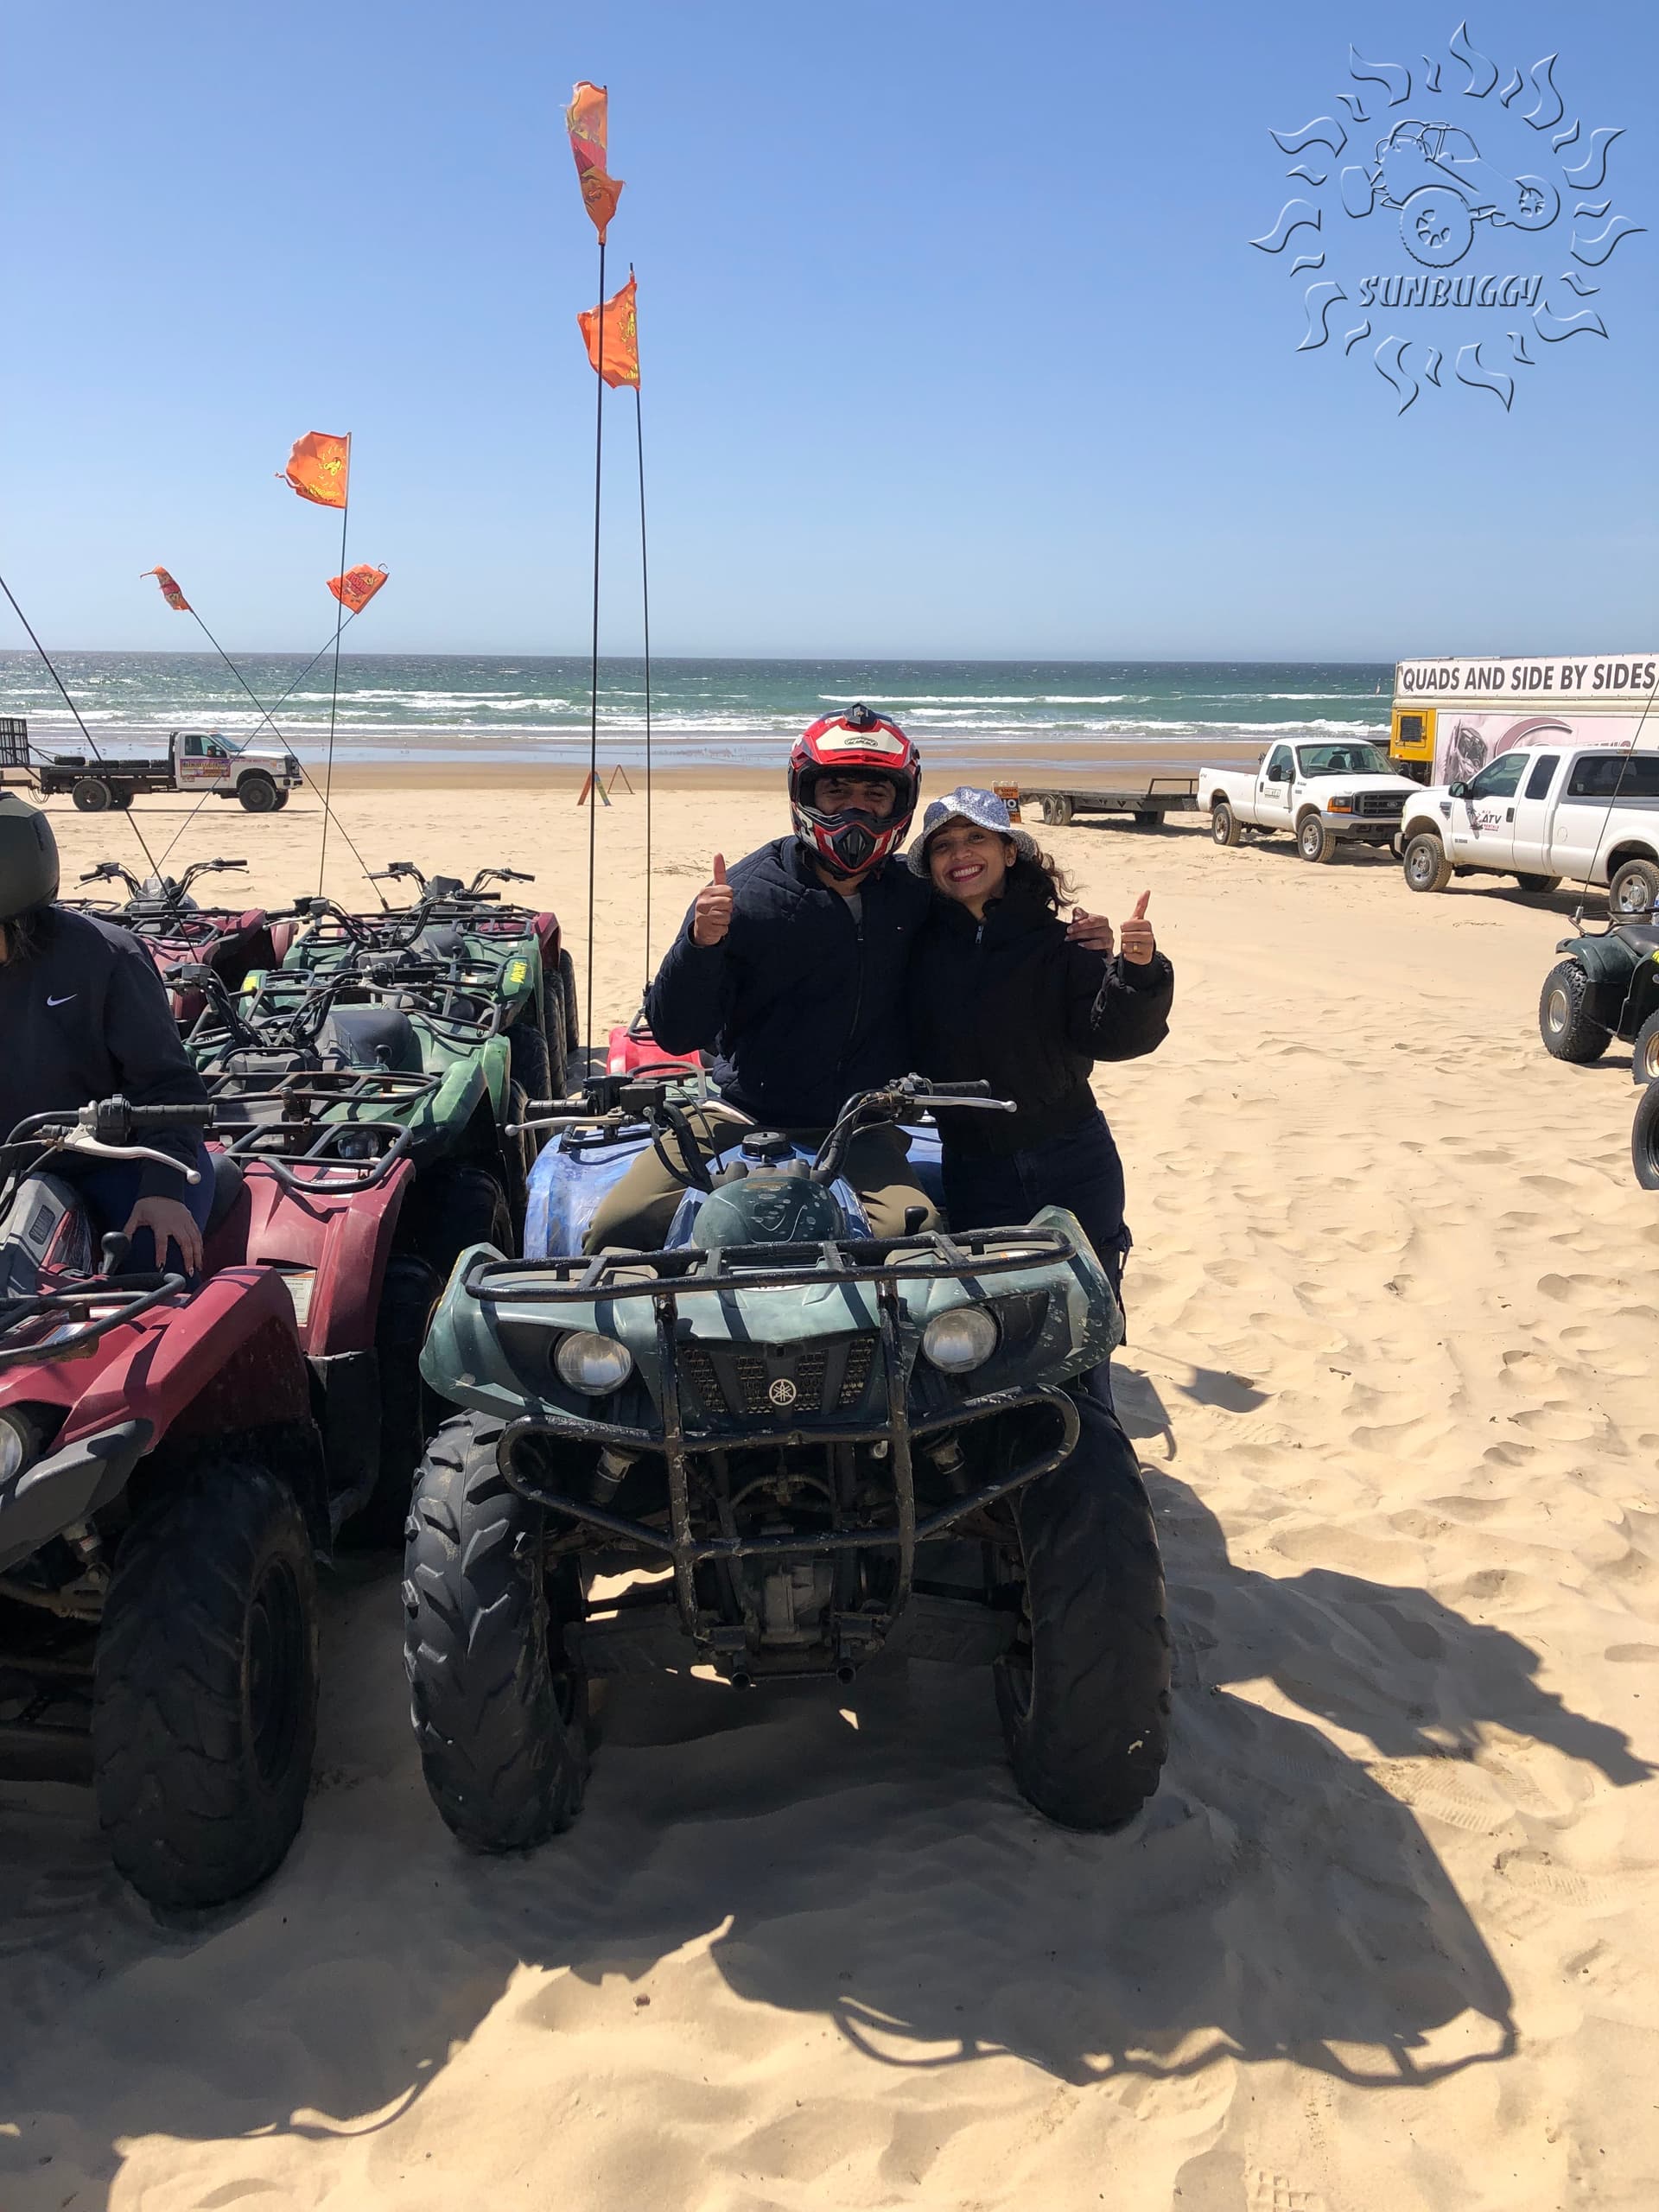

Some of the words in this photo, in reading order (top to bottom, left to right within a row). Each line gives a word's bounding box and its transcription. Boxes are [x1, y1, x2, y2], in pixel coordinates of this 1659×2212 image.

[1402, 666, 1460, 692] QUADS
[1465, 666, 1505, 690] AND
[1511, 665, 1554, 690] SIDE
[1560, 664, 1588, 690] BY
[1592, 662, 1657, 690] SIDES
[1482, 814, 1502, 823] ATV
